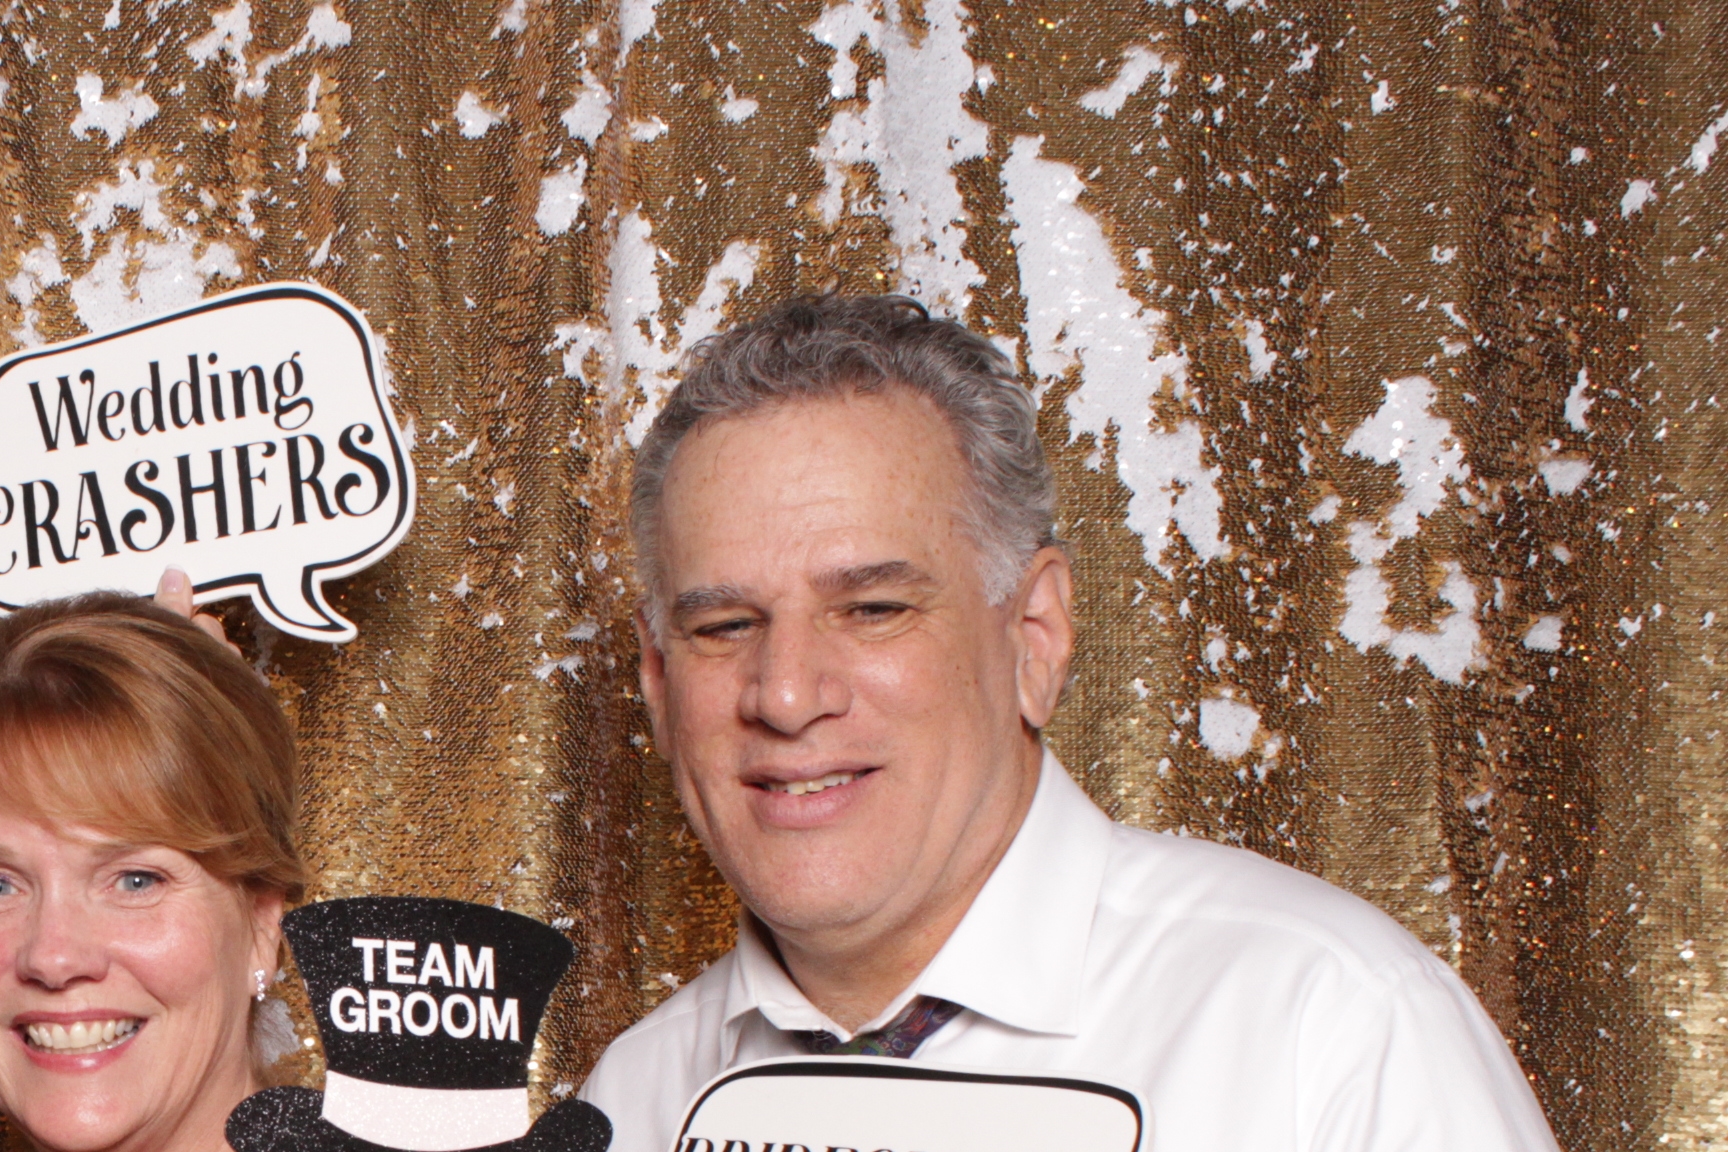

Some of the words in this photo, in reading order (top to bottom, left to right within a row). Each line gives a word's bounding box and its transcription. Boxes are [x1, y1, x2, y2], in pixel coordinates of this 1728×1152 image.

[27, 351, 314, 452] Wedding
[351, 937, 496, 990] TEAM
[329, 986, 521, 1042] GROOM
